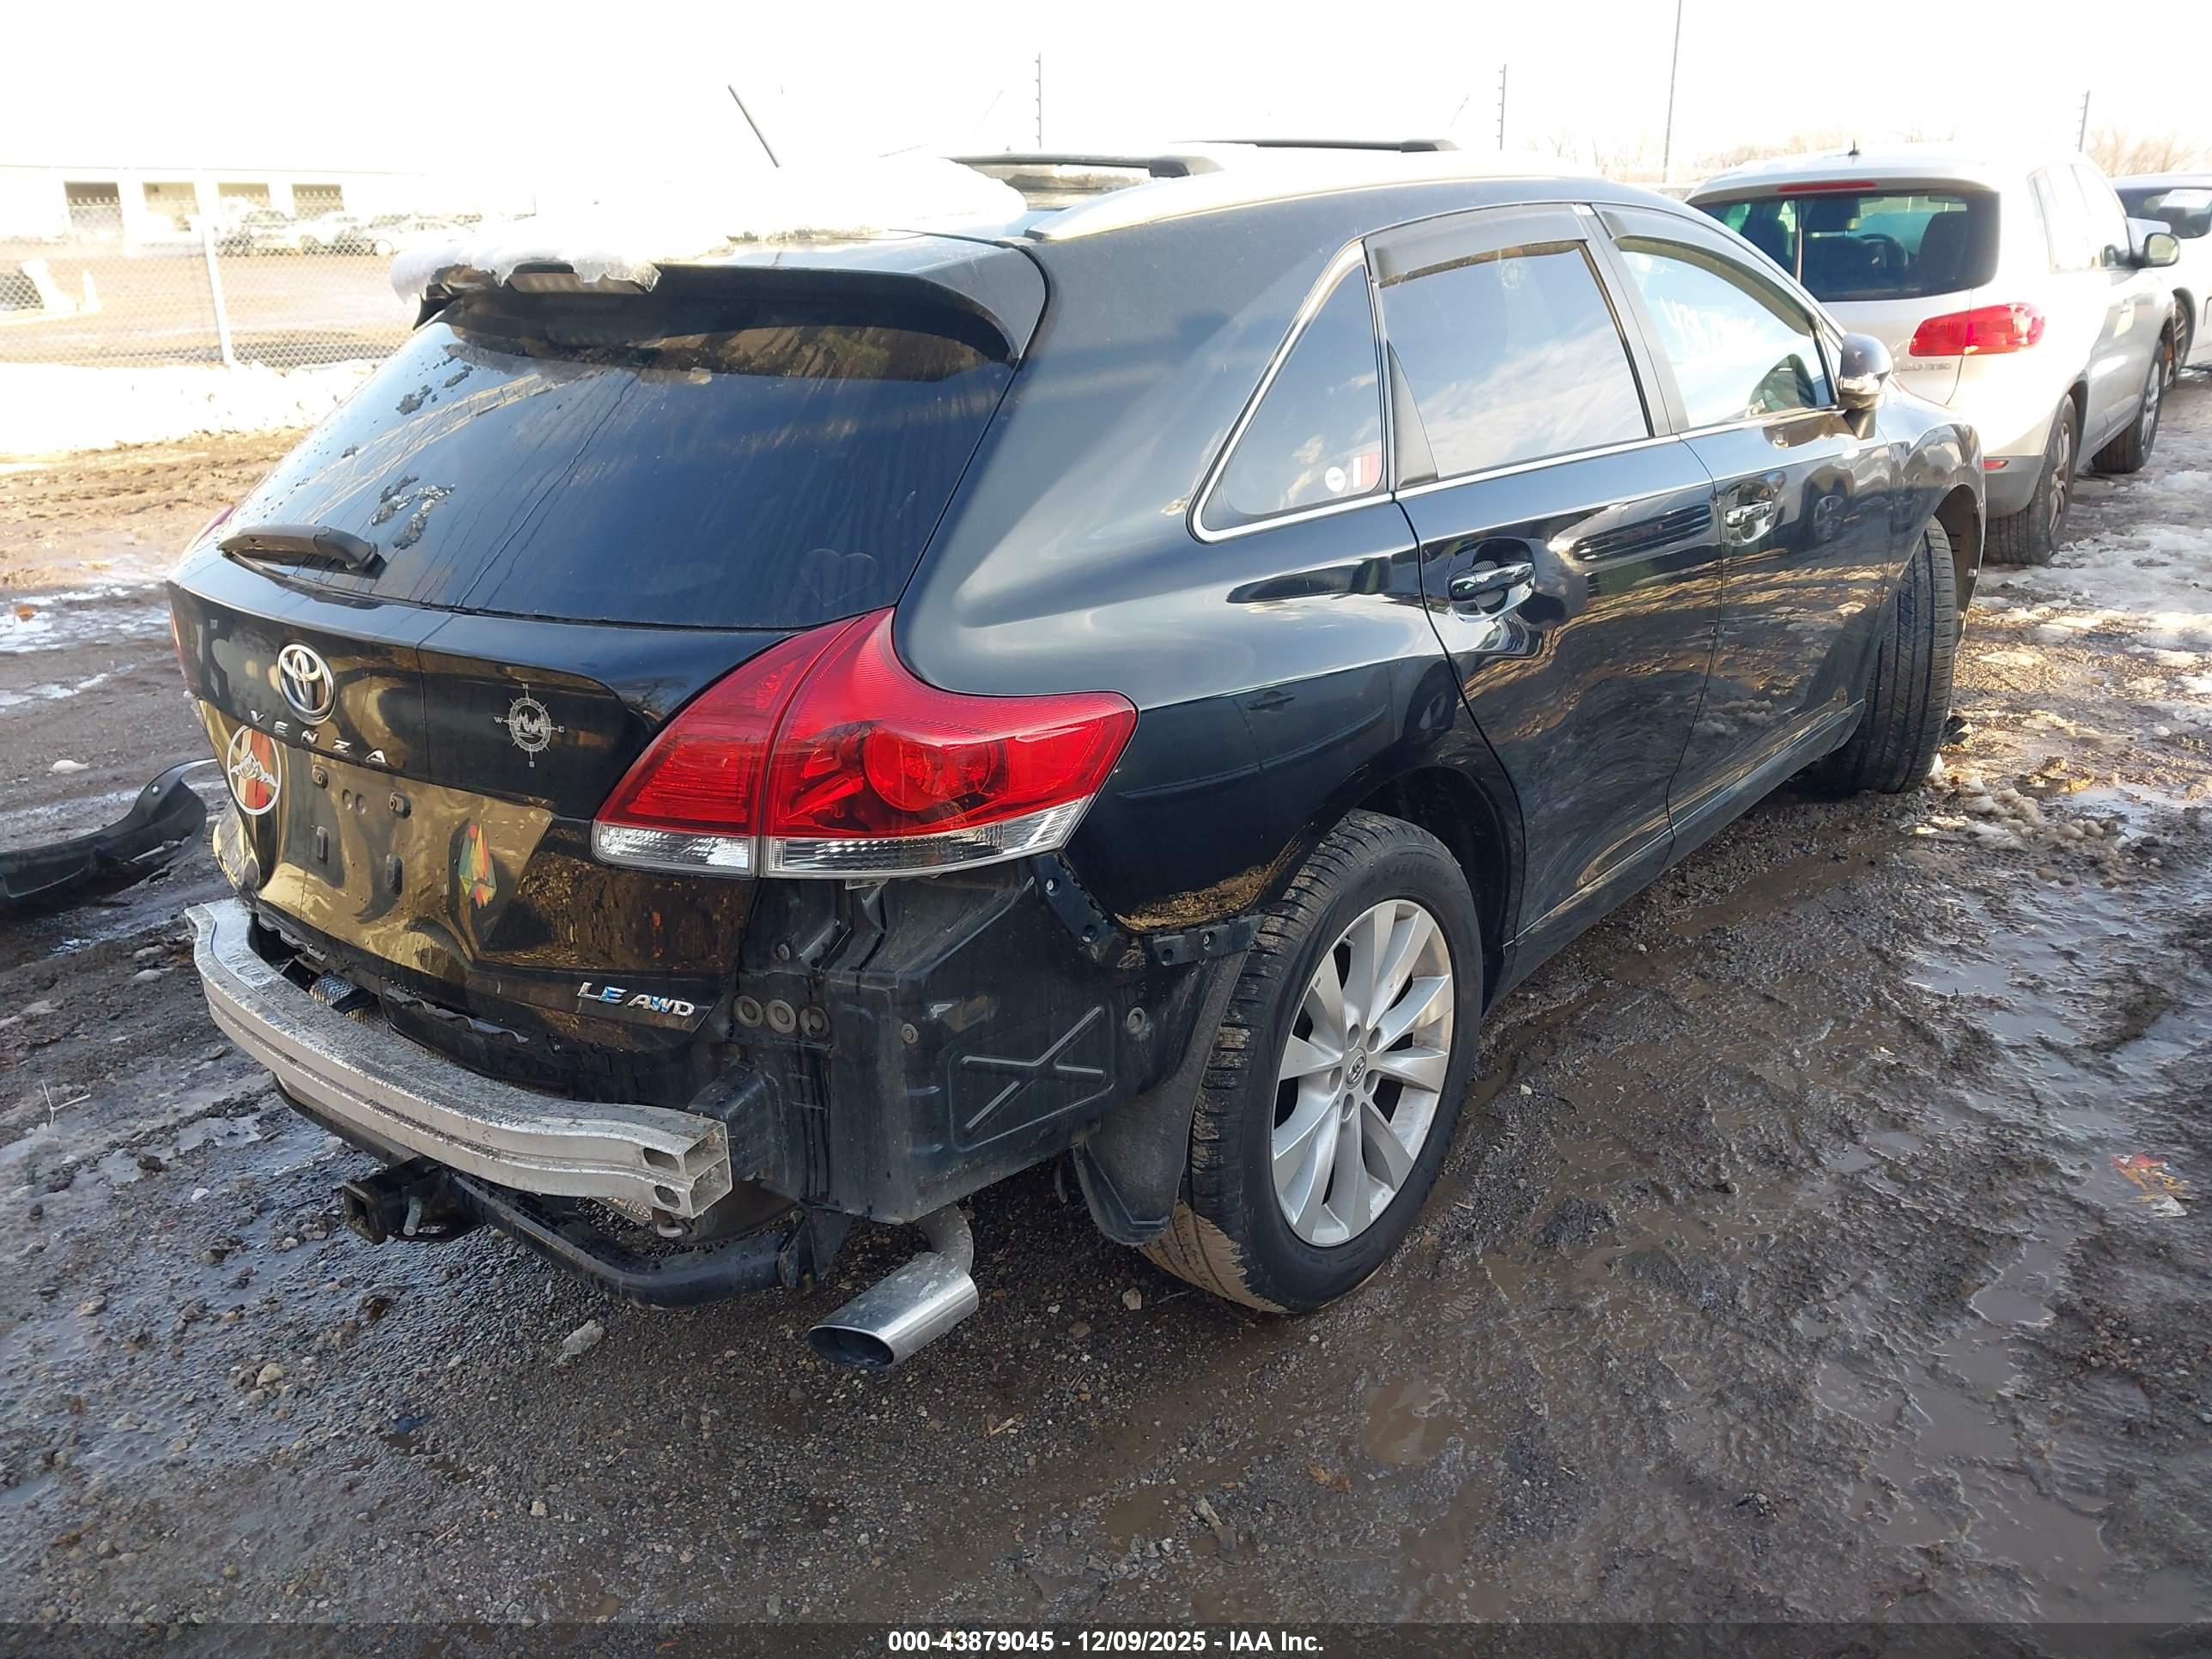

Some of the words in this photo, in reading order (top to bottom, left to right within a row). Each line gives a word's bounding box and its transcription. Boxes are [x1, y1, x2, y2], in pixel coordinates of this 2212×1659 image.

[249, 709, 386, 763] VENZA
[577, 981, 628, 1005] LE
[627, 994, 696, 1017] AWD
